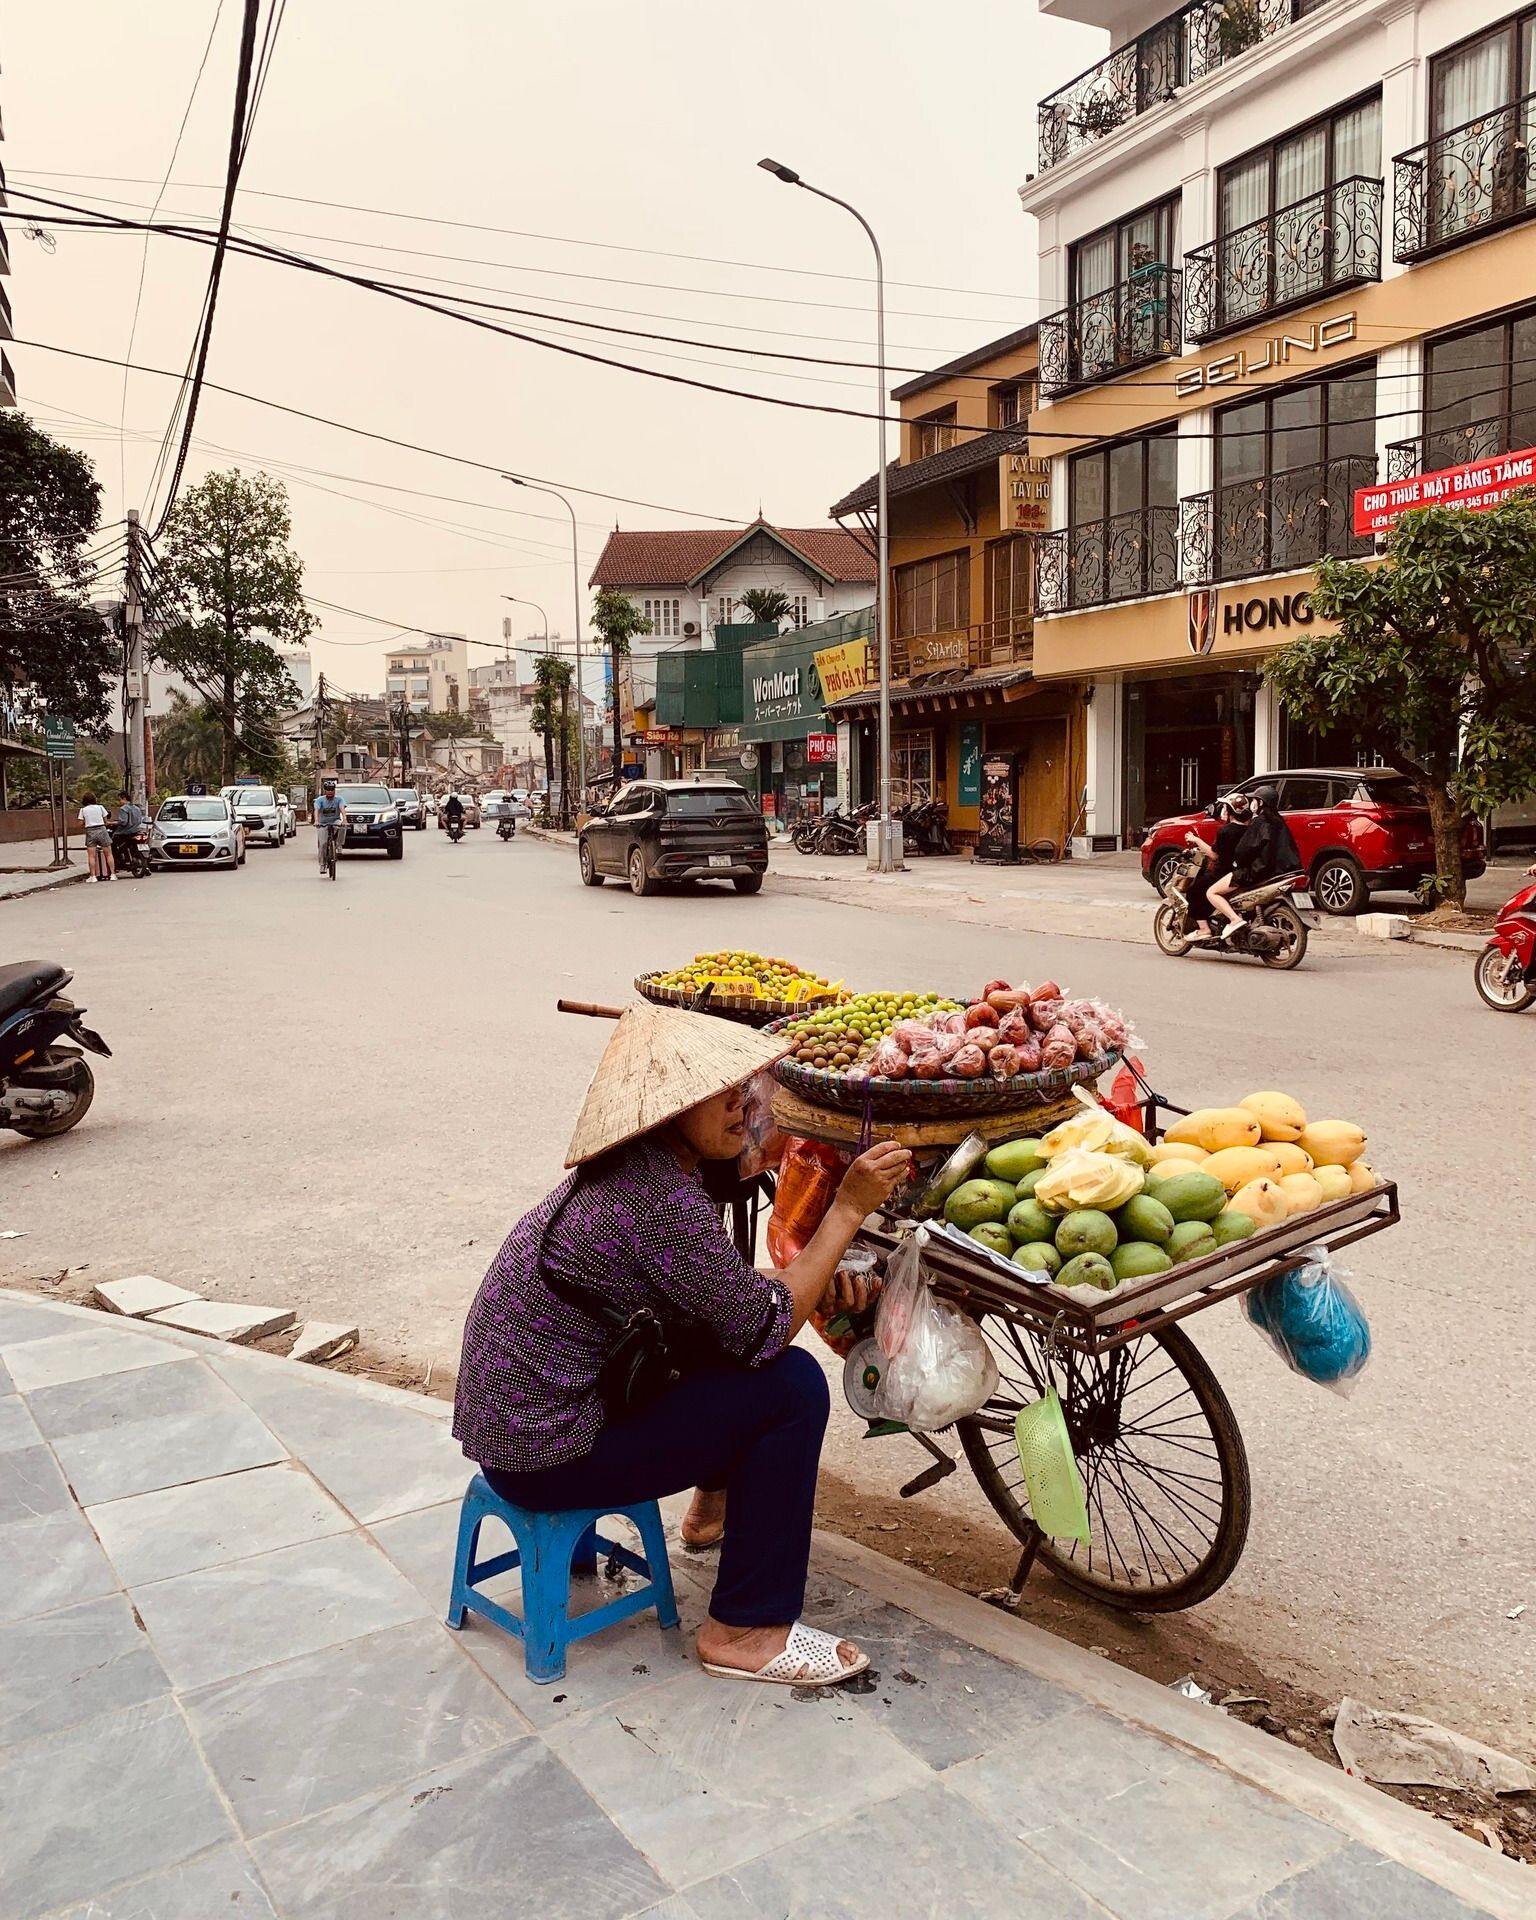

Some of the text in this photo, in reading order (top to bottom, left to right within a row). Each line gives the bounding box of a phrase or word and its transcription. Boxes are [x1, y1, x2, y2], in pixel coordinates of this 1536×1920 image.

[1175, 311, 1357, 398] BEIJING
[1363, 494, 1387, 512] CHO
[1390, 483, 1420, 506] THUÊ
[1423, 476, 1451, 499] MẶT
[1454, 466, 1492, 491] BẰNG
[1494, 458, 1533, 480] TẦNG
[1466, 497, 1481, 510] 345
[1483, 493, 1498, 505] 678
[1224, 591, 1342, 636] HONG
[752, 667, 800, 703] WonMart
[842, 664, 855, 689] GÀ
[754, 697, 802, 721] スーパーマーケット
[810, 736, 837, 753] PHỞ GÀ
